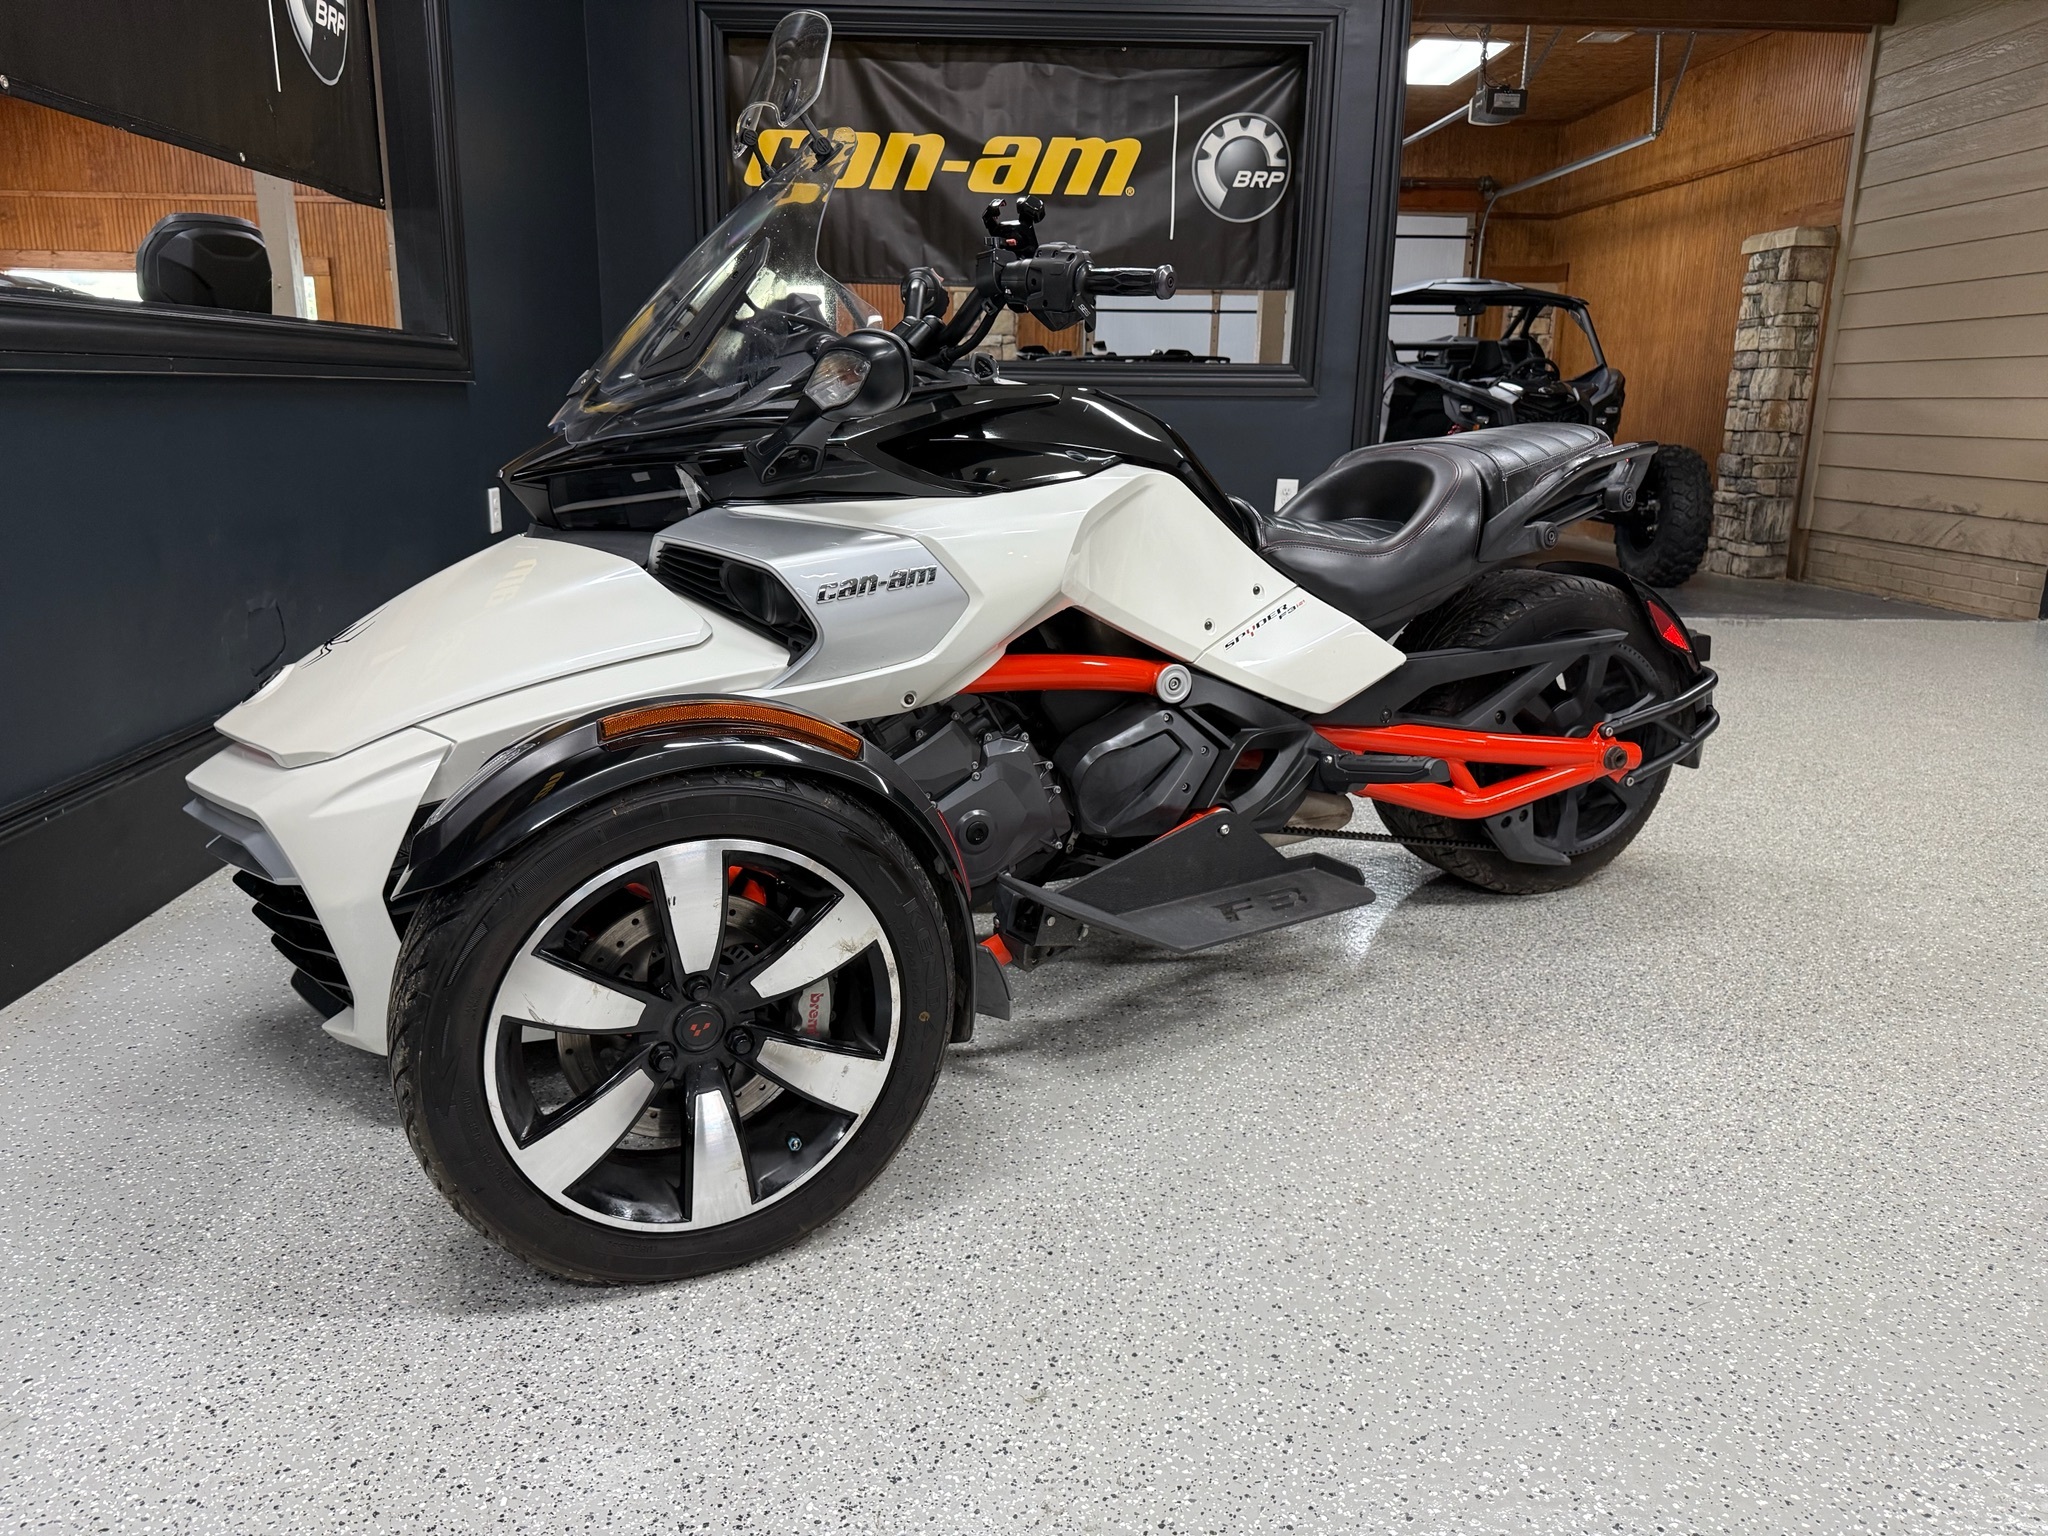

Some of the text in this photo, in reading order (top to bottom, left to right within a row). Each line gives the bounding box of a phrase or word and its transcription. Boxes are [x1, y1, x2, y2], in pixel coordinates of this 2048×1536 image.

[315, 0, 345, 37] BRP
[1232, 170, 1285, 190] BRP
[816, 564, 938, 604] can-am
[1224, 603, 1287, 651] SPYDER
[806, 993, 825, 1037] brem
